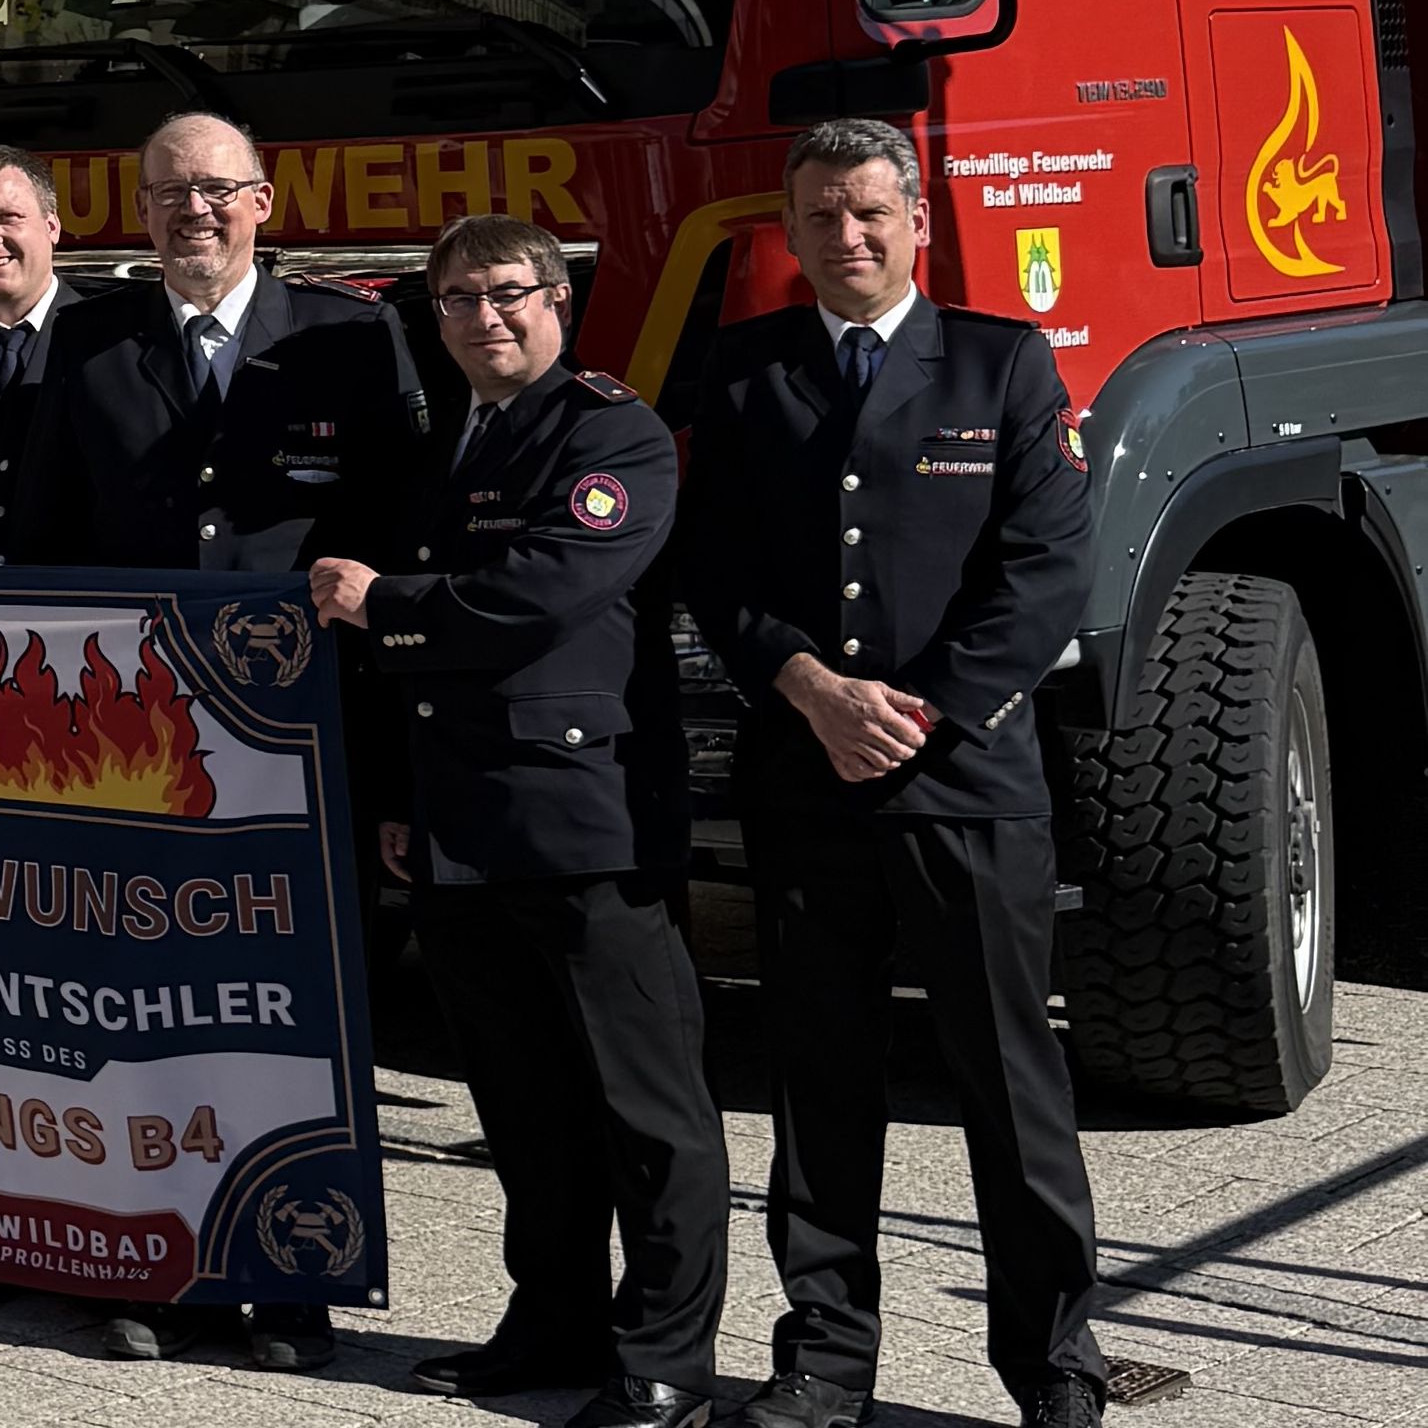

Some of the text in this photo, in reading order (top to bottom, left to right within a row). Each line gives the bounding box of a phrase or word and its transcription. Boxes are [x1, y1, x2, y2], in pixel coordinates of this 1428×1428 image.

[944, 149, 1114, 179] Freiwillige Feuerwehr
[983, 182, 1082, 208] Bad Wildbad
[1040, 325, 1089, 349] ildbad
[42, 1044, 87, 1070] DES
[127, 1104, 225, 1172] B4
